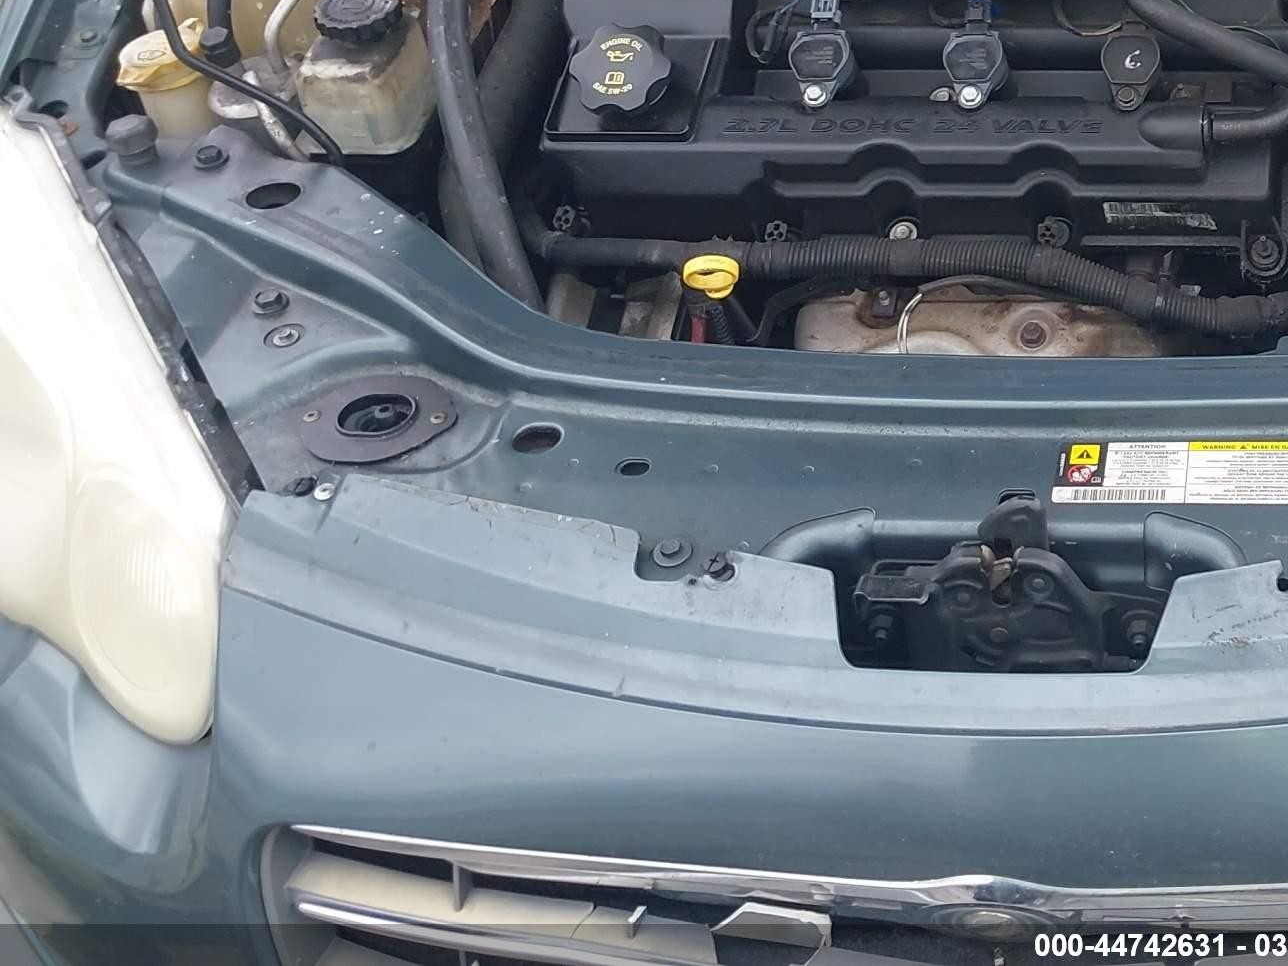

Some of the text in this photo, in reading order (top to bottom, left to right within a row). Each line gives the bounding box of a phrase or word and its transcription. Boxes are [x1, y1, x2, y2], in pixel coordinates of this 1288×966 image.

[600, 37, 643, 52] ENGINE OIL
[592, 82, 608, 94] SAE
[723, 118, 1104, 134] 2.7L DOHC 24 VALVE
